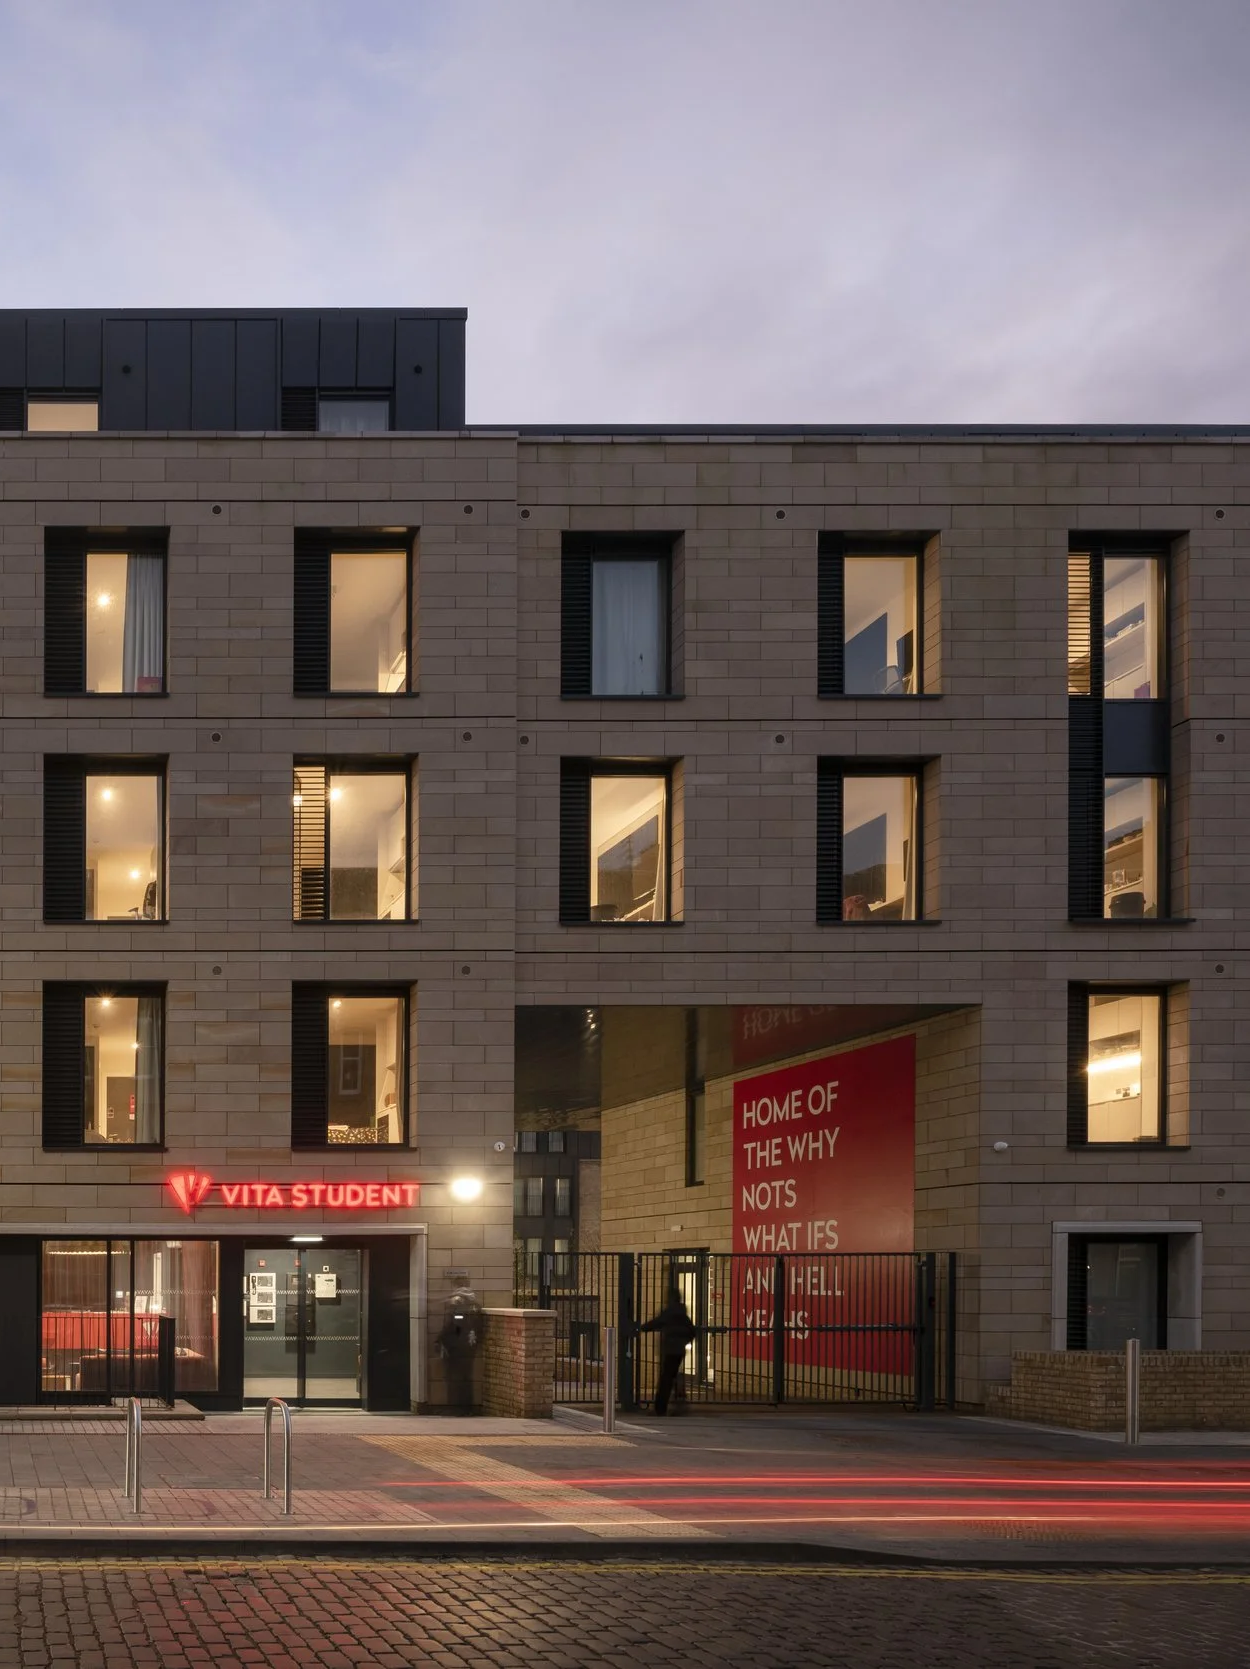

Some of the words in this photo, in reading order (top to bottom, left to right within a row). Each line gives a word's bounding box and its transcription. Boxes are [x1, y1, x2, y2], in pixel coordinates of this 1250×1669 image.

[743, 1089, 803, 1130] HOME
[808, 1080, 839, 1115] OF
[743, 1137, 783, 1170] THE
[787, 1126, 840, 1163] WHY
[221, 1184, 284, 1206] VITA
[292, 1184, 419, 1206] STUDENT
[742, 1179, 797, 1212] NOTS
[742, 1222, 802, 1252] WHAT
[807, 1219, 839, 1250] IFS
[742, 1266, 781, 1295] AN
[791, 1265, 845, 1296] HELL
